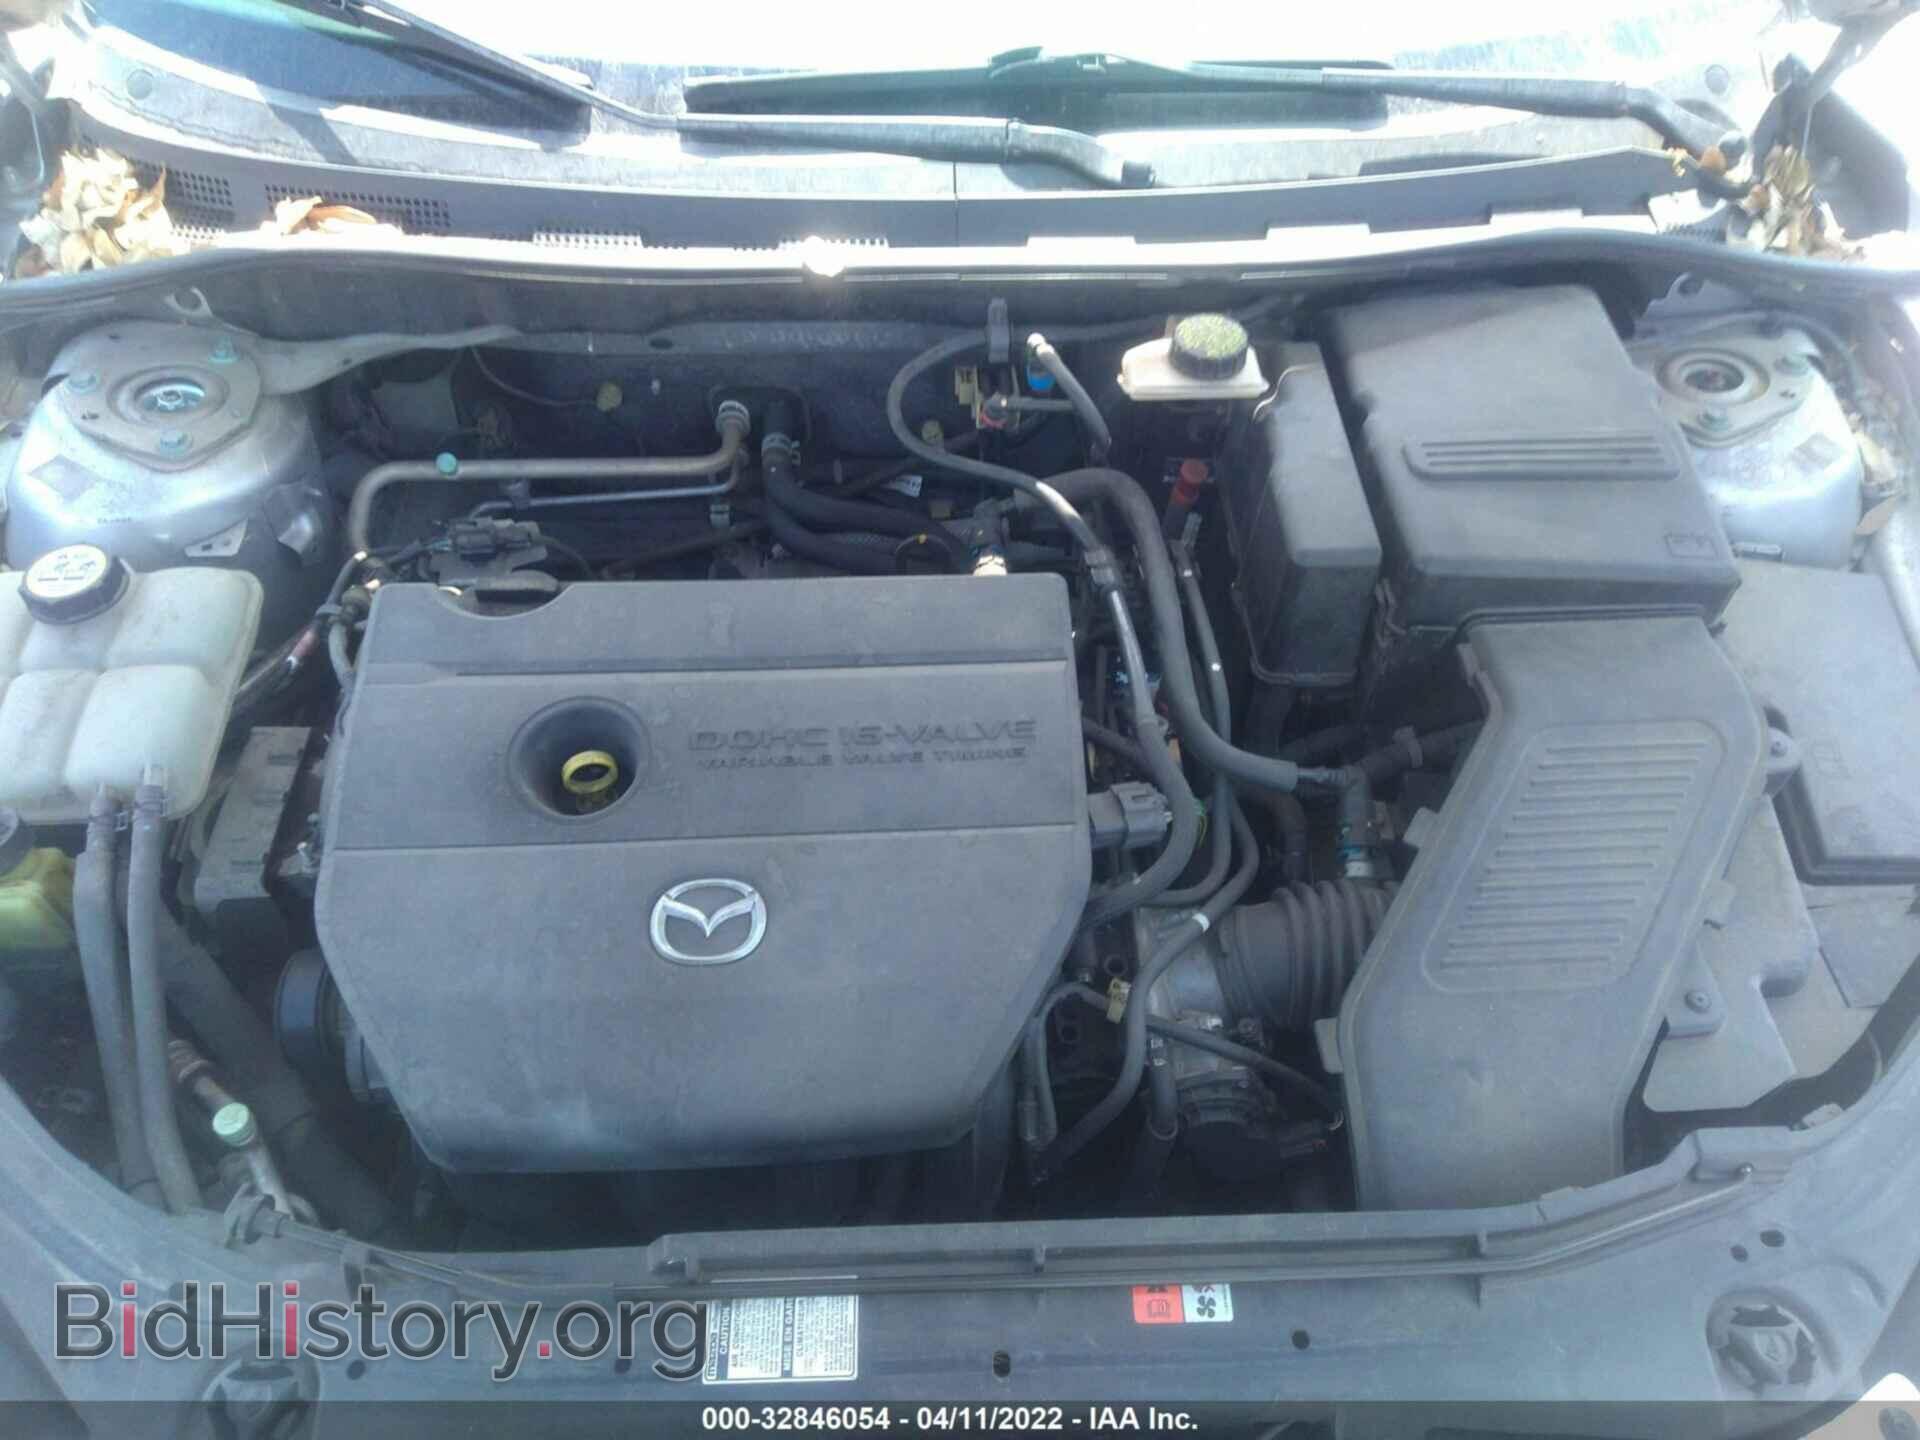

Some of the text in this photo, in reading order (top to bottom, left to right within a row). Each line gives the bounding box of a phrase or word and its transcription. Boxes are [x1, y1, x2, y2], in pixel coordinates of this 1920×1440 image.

[688, 720, 1036, 750] DOHC 16-VALVE
[719, 1307, 730, 1354] CAUTION
